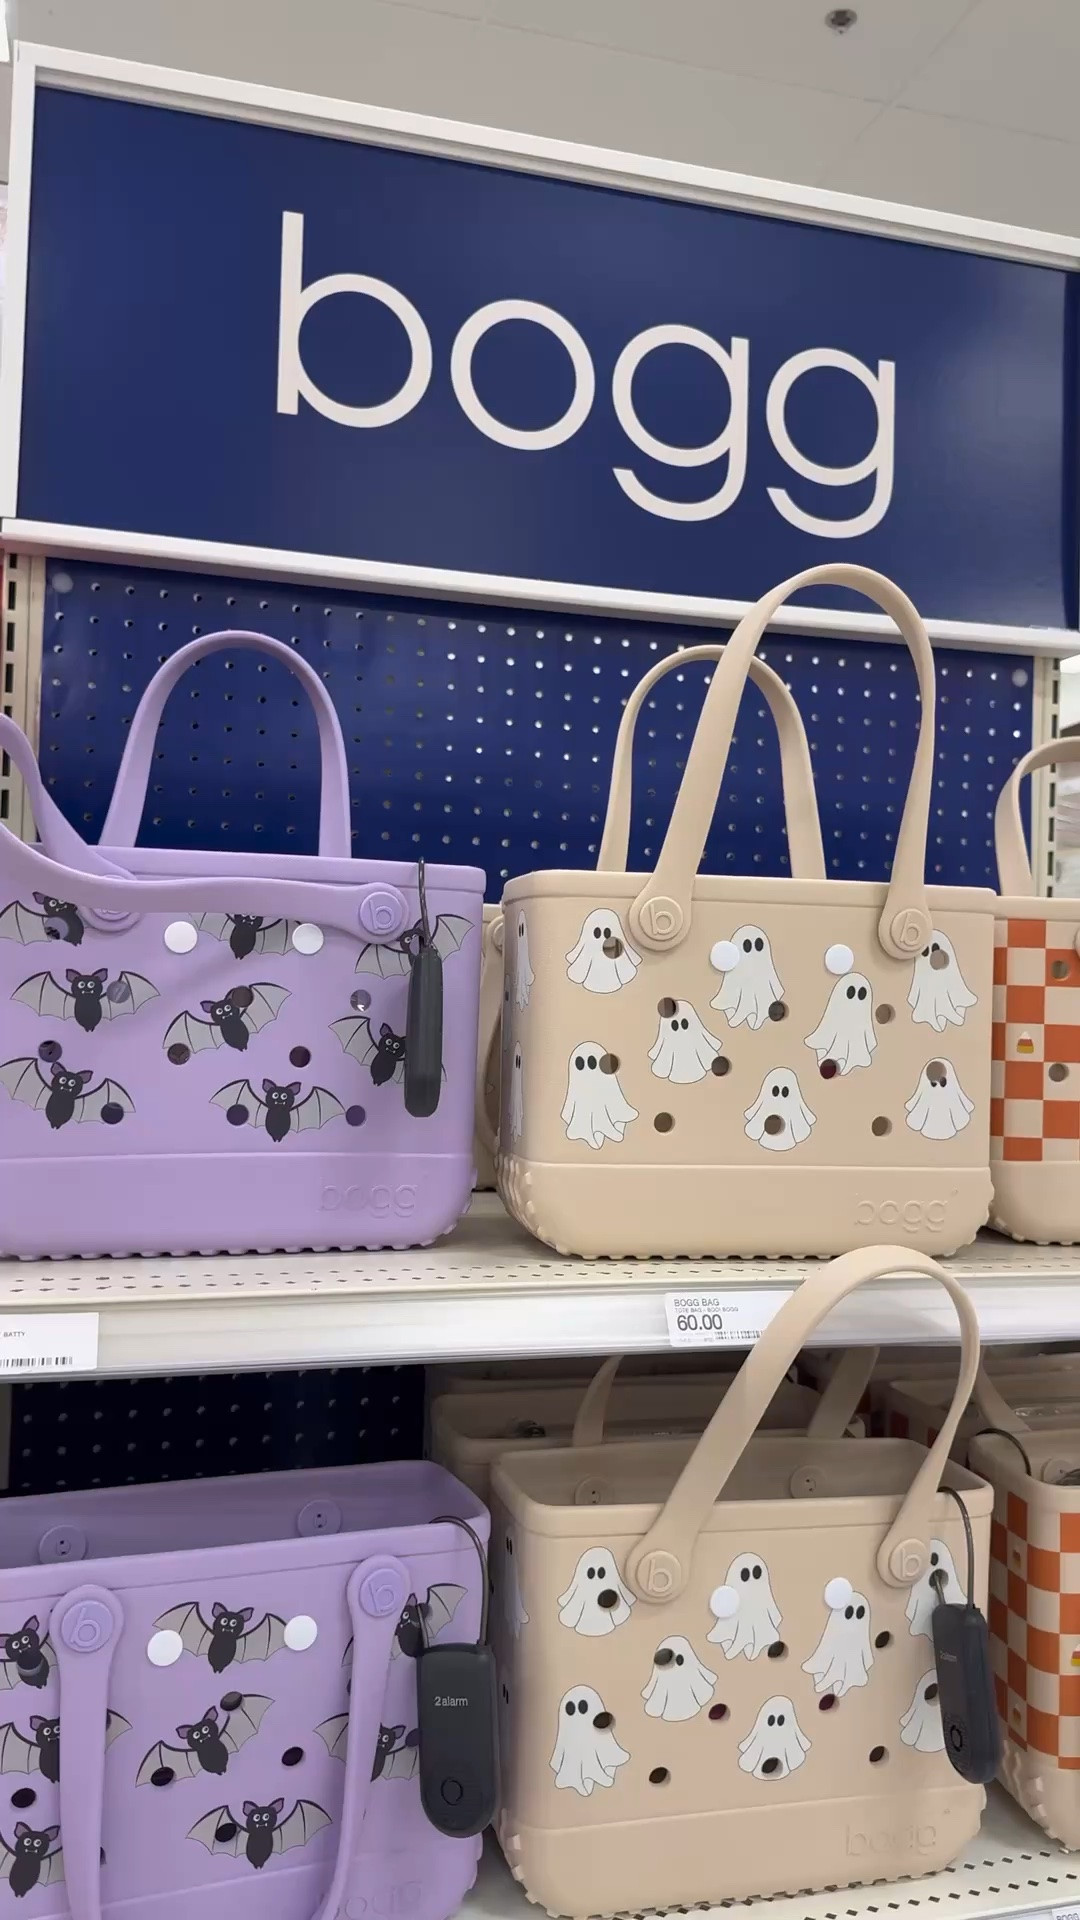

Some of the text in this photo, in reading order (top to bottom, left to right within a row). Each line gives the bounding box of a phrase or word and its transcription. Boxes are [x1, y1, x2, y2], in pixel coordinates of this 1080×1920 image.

[277, 211, 896, 539] bogg
[370, 899, 396, 931] b
[649, 904, 672, 935] b
[901, 912, 922, 945] b
[673, 1298, 720, 1307] BOGG BAG
[677, 1313, 723, 1331] 60.00
[648, 1558, 673, 1593] b
[900, 1548, 921, 1577] b
[369, 1581, 395, 1613] b
[69, 1606, 100, 1648] b
